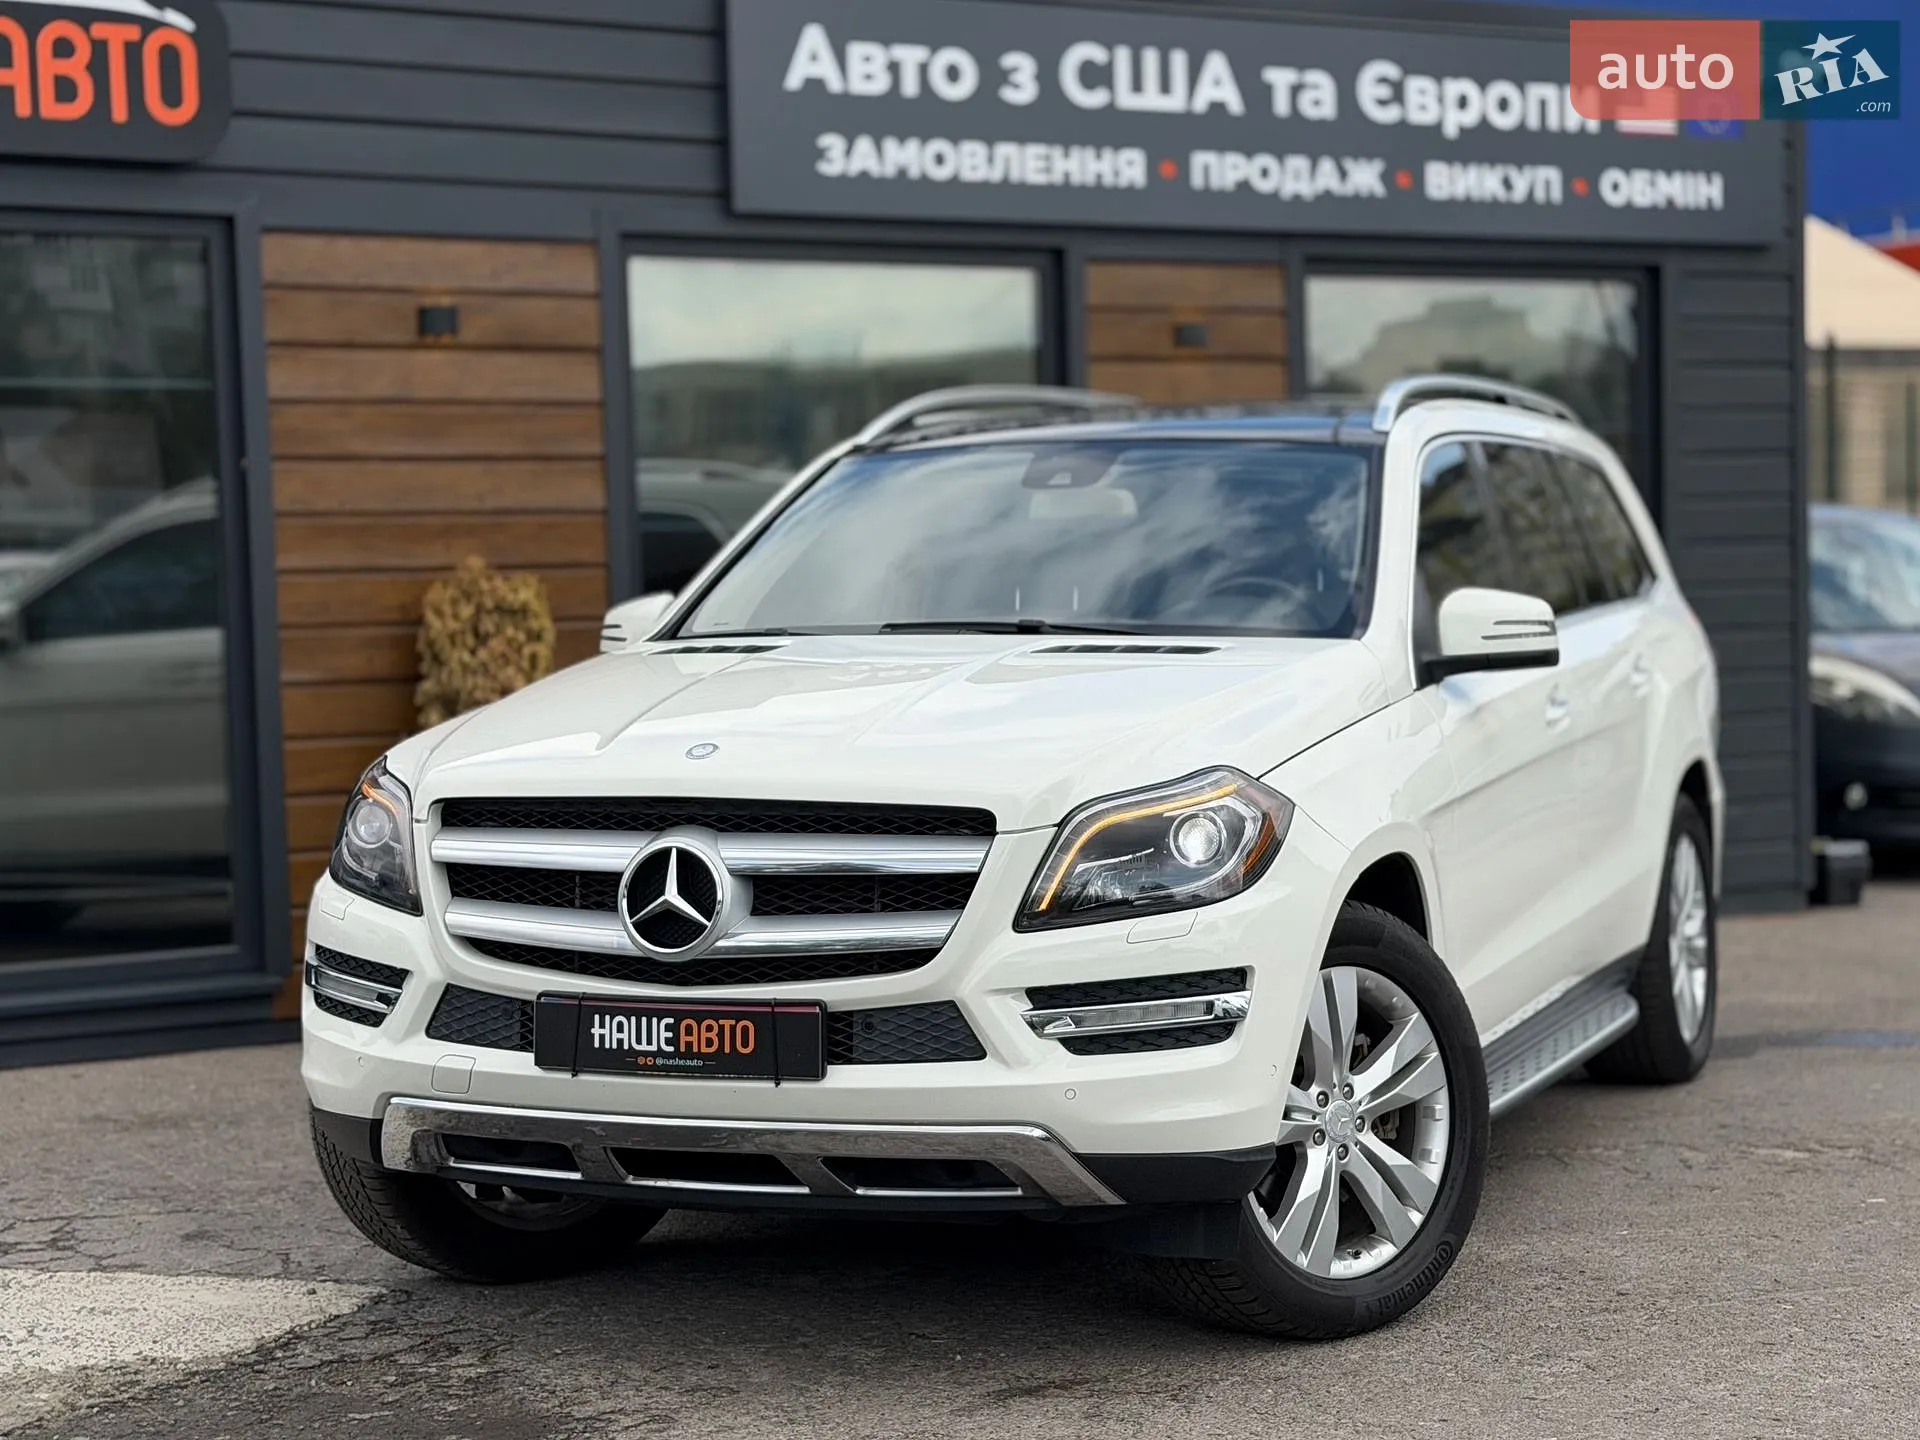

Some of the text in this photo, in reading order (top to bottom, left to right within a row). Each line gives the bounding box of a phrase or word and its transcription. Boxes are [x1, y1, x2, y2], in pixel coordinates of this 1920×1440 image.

[783, 22, 1601, 140] Авто з США та Європи
[815, 133, 1724, 210] ЗАМОВЛЕННЯ ПРОДАЖ ВИКУП ОБМІН
[590, 1013, 755, 1054] НАШЕ АВТО
